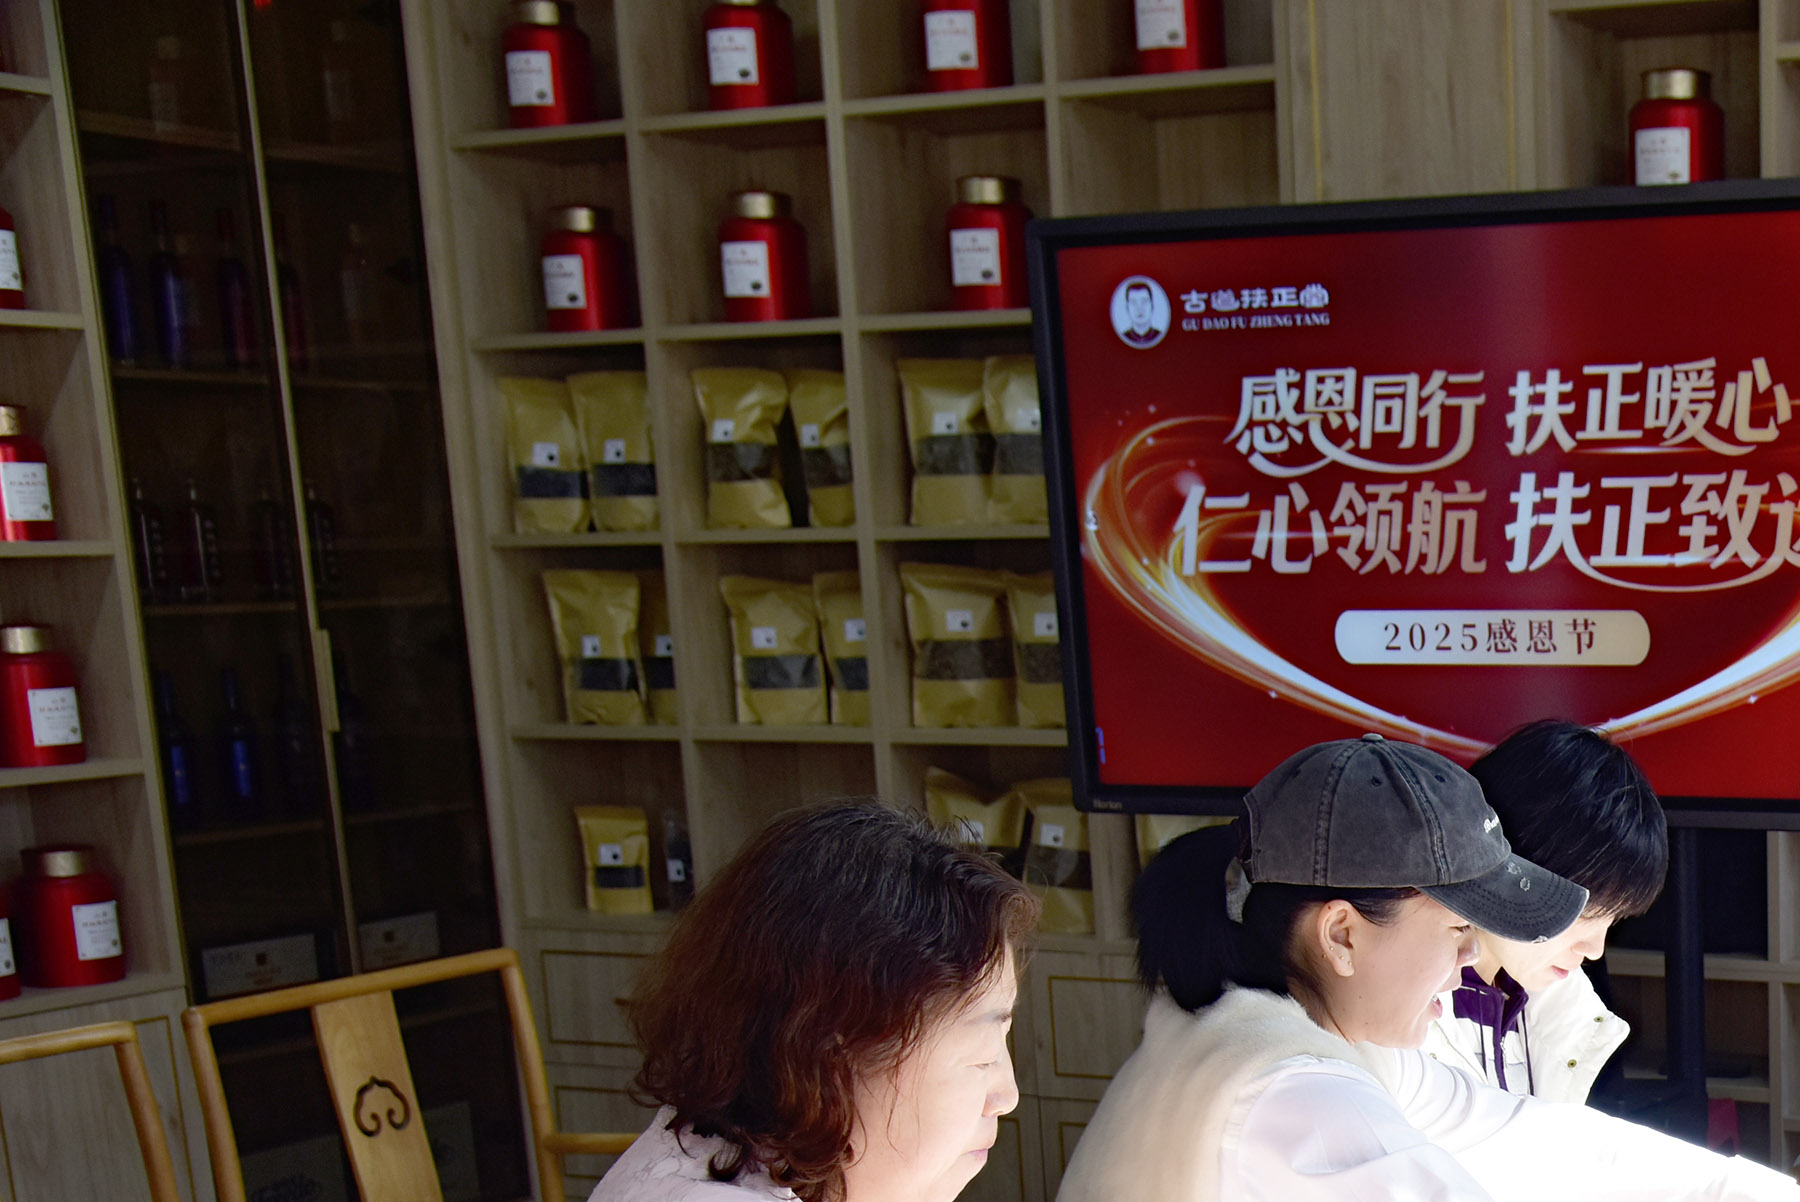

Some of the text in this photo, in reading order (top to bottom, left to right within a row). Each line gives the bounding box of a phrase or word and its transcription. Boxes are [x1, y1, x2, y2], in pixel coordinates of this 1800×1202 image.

[1180, 282, 1329, 314] 古道扶正堂
[1181, 312, 1330, 331] GU DAO FU ZHENG TANG
[1222, 356, 1793, 478] 感恩同行 扶正暖心
[1174, 479, 1488, 578] 仁心领航
[1382, 618, 1598, 656] 2025感恩节
